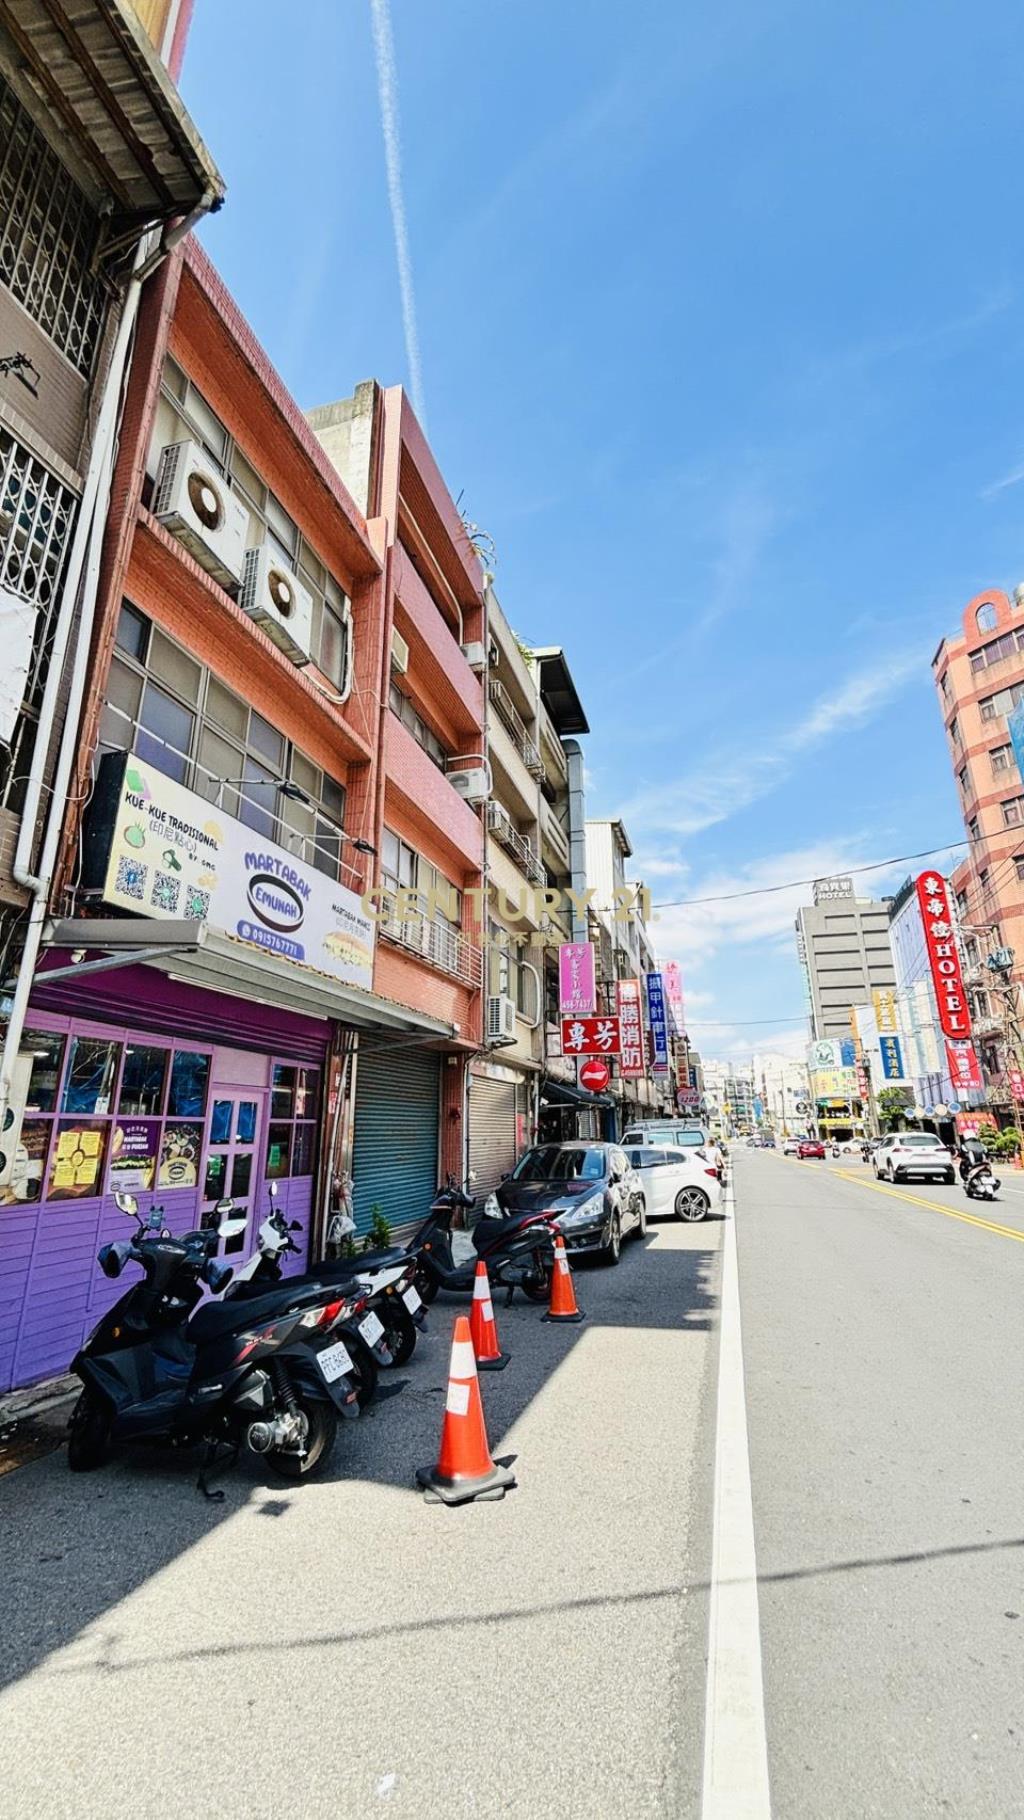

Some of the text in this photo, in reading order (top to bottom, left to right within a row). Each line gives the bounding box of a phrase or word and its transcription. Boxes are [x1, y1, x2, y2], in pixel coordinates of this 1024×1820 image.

[125, 792, 219, 851] KUE-KUE TRADISIONAL
[244, 851, 312, 901] MARTABAK
[818, 891, 853, 900] HOTEL
[255, 885, 298, 918] EMUNAH
[935, 943, 965, 1030] HOTEL
